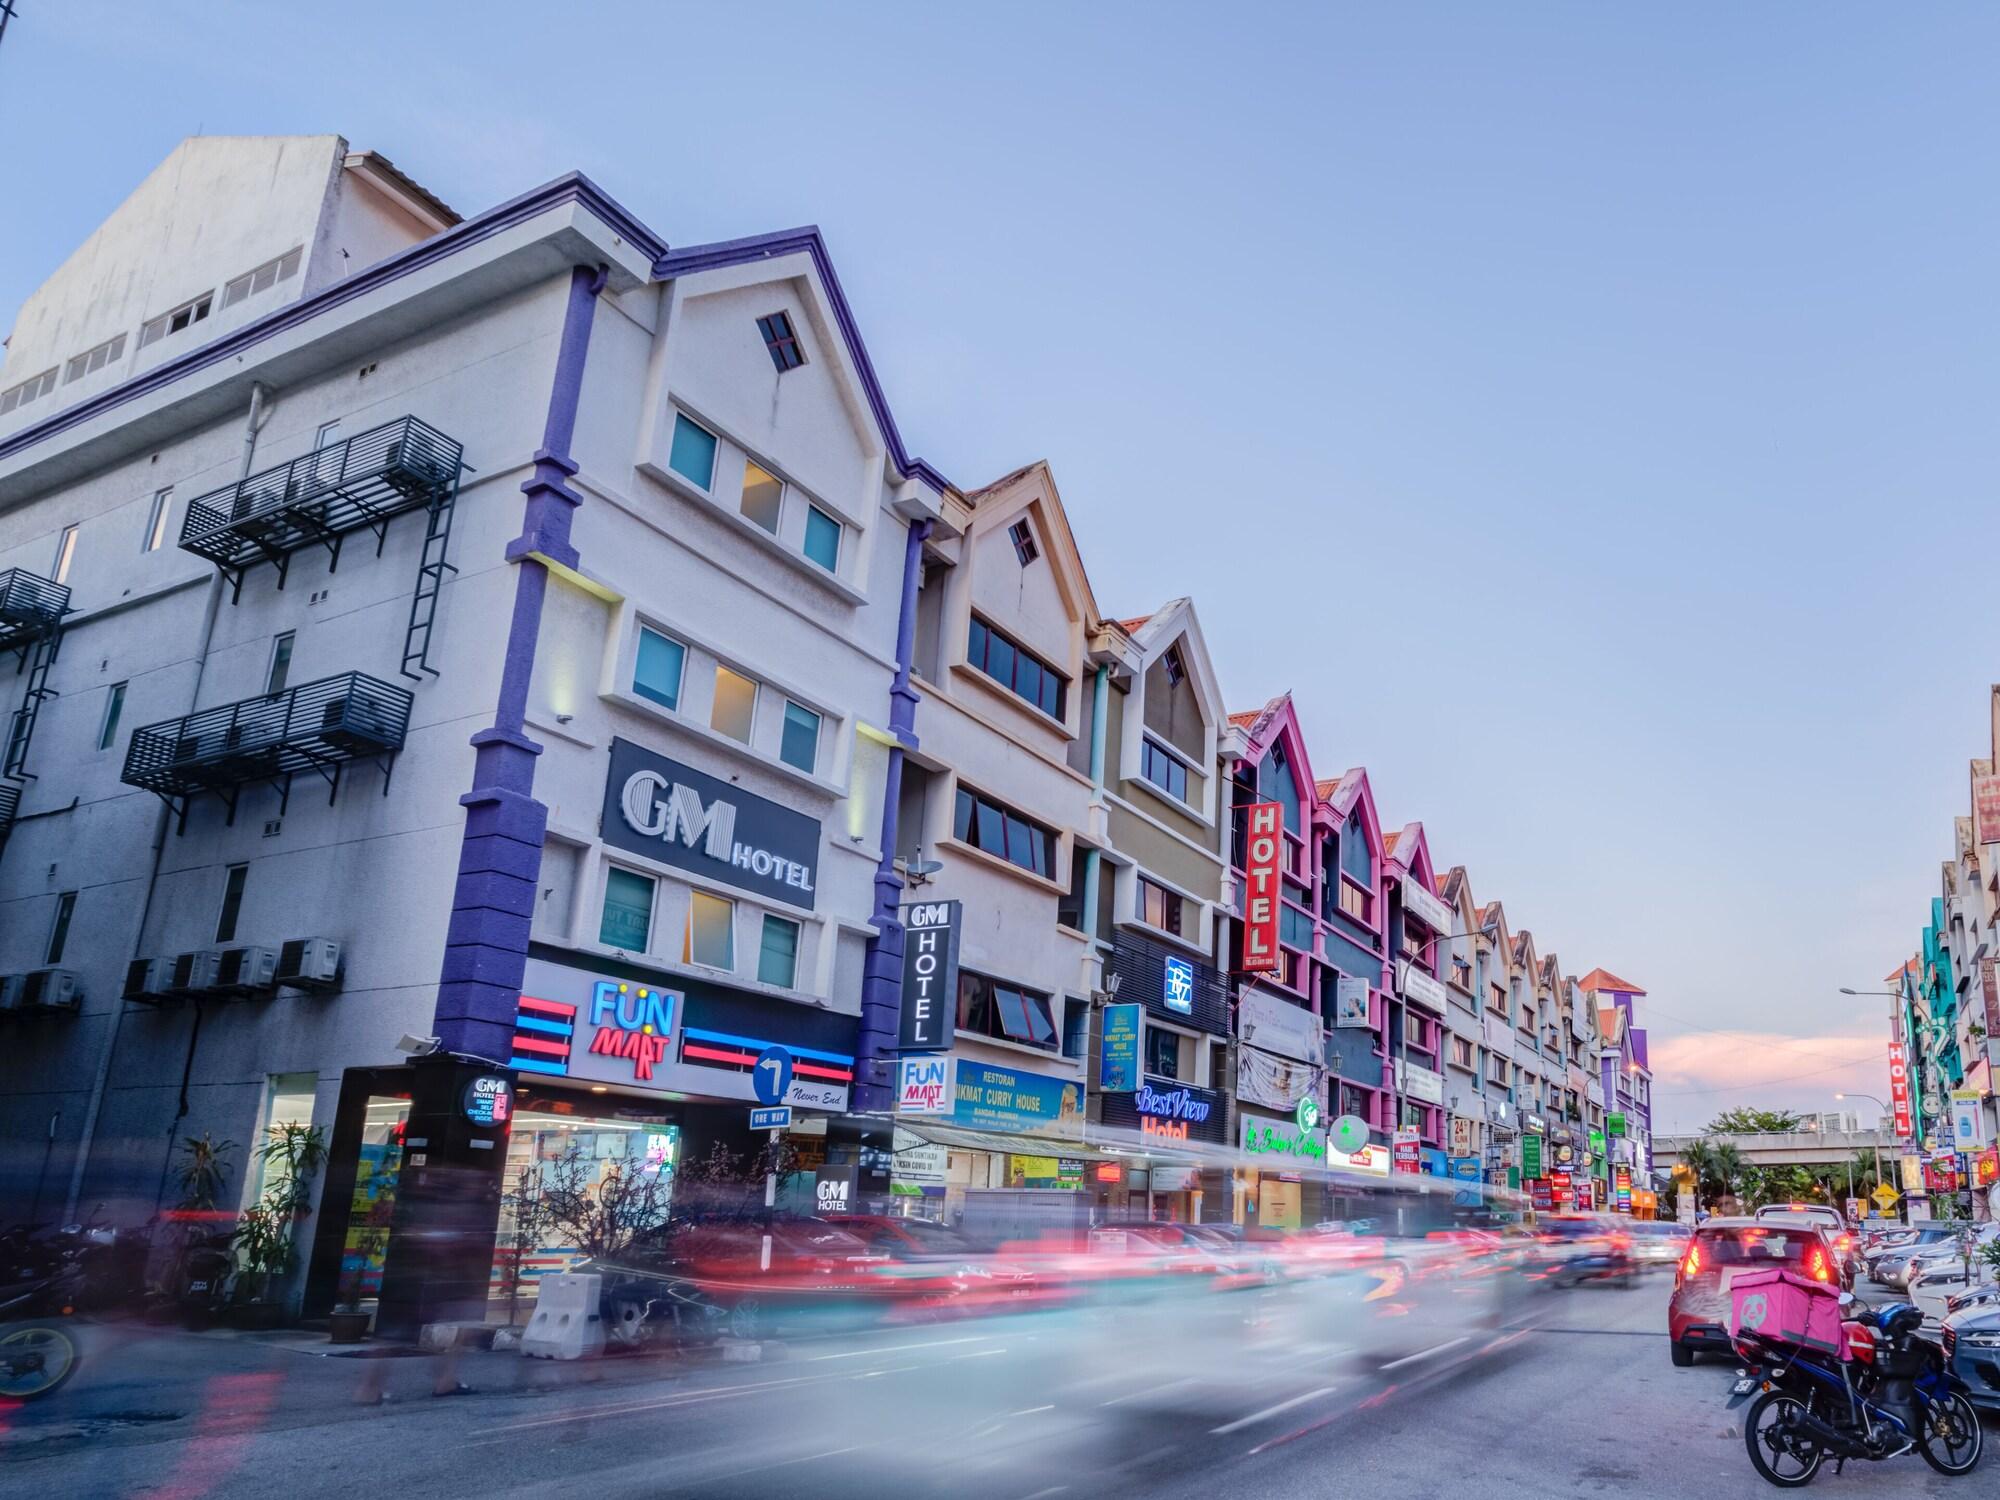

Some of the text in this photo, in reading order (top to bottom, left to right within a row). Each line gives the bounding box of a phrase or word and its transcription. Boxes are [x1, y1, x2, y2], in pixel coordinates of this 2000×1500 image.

[621, 769, 736, 863] GM
[732, 842, 814, 892] HOTEL
[1250, 807, 1275, 954] HOTEL
[911, 903, 949, 927] GM
[914, 932, 937, 1042] HOTEL
[588, 1026, 671, 1081] MART
[475, 1079, 506, 1093] GM
[983, 1071, 1016, 1088] RESTORAN
[1889, 1047, 1909, 1132] HOTEL
[792, 1087, 841, 1104] Never End
[905, 1085, 944, 1109] MART
[987, 1091, 1012, 1109] CURRY
[1016, 1095, 1041, 1112] HOUSE
[754, 1112, 785, 1123] ONE WAY
[1455, 1120, 1464, 1135] 24
[1142, 1115, 1187, 1141] Hotel
[1396, 1152, 1418, 1161] TERBUKA
[1400, 1145, 1414, 1153] HARI
[912, 1162, 926, 1171] COVID
[817, 1180, 849, 1200] GM
[818, 1200, 847, 1211] HOTEL
